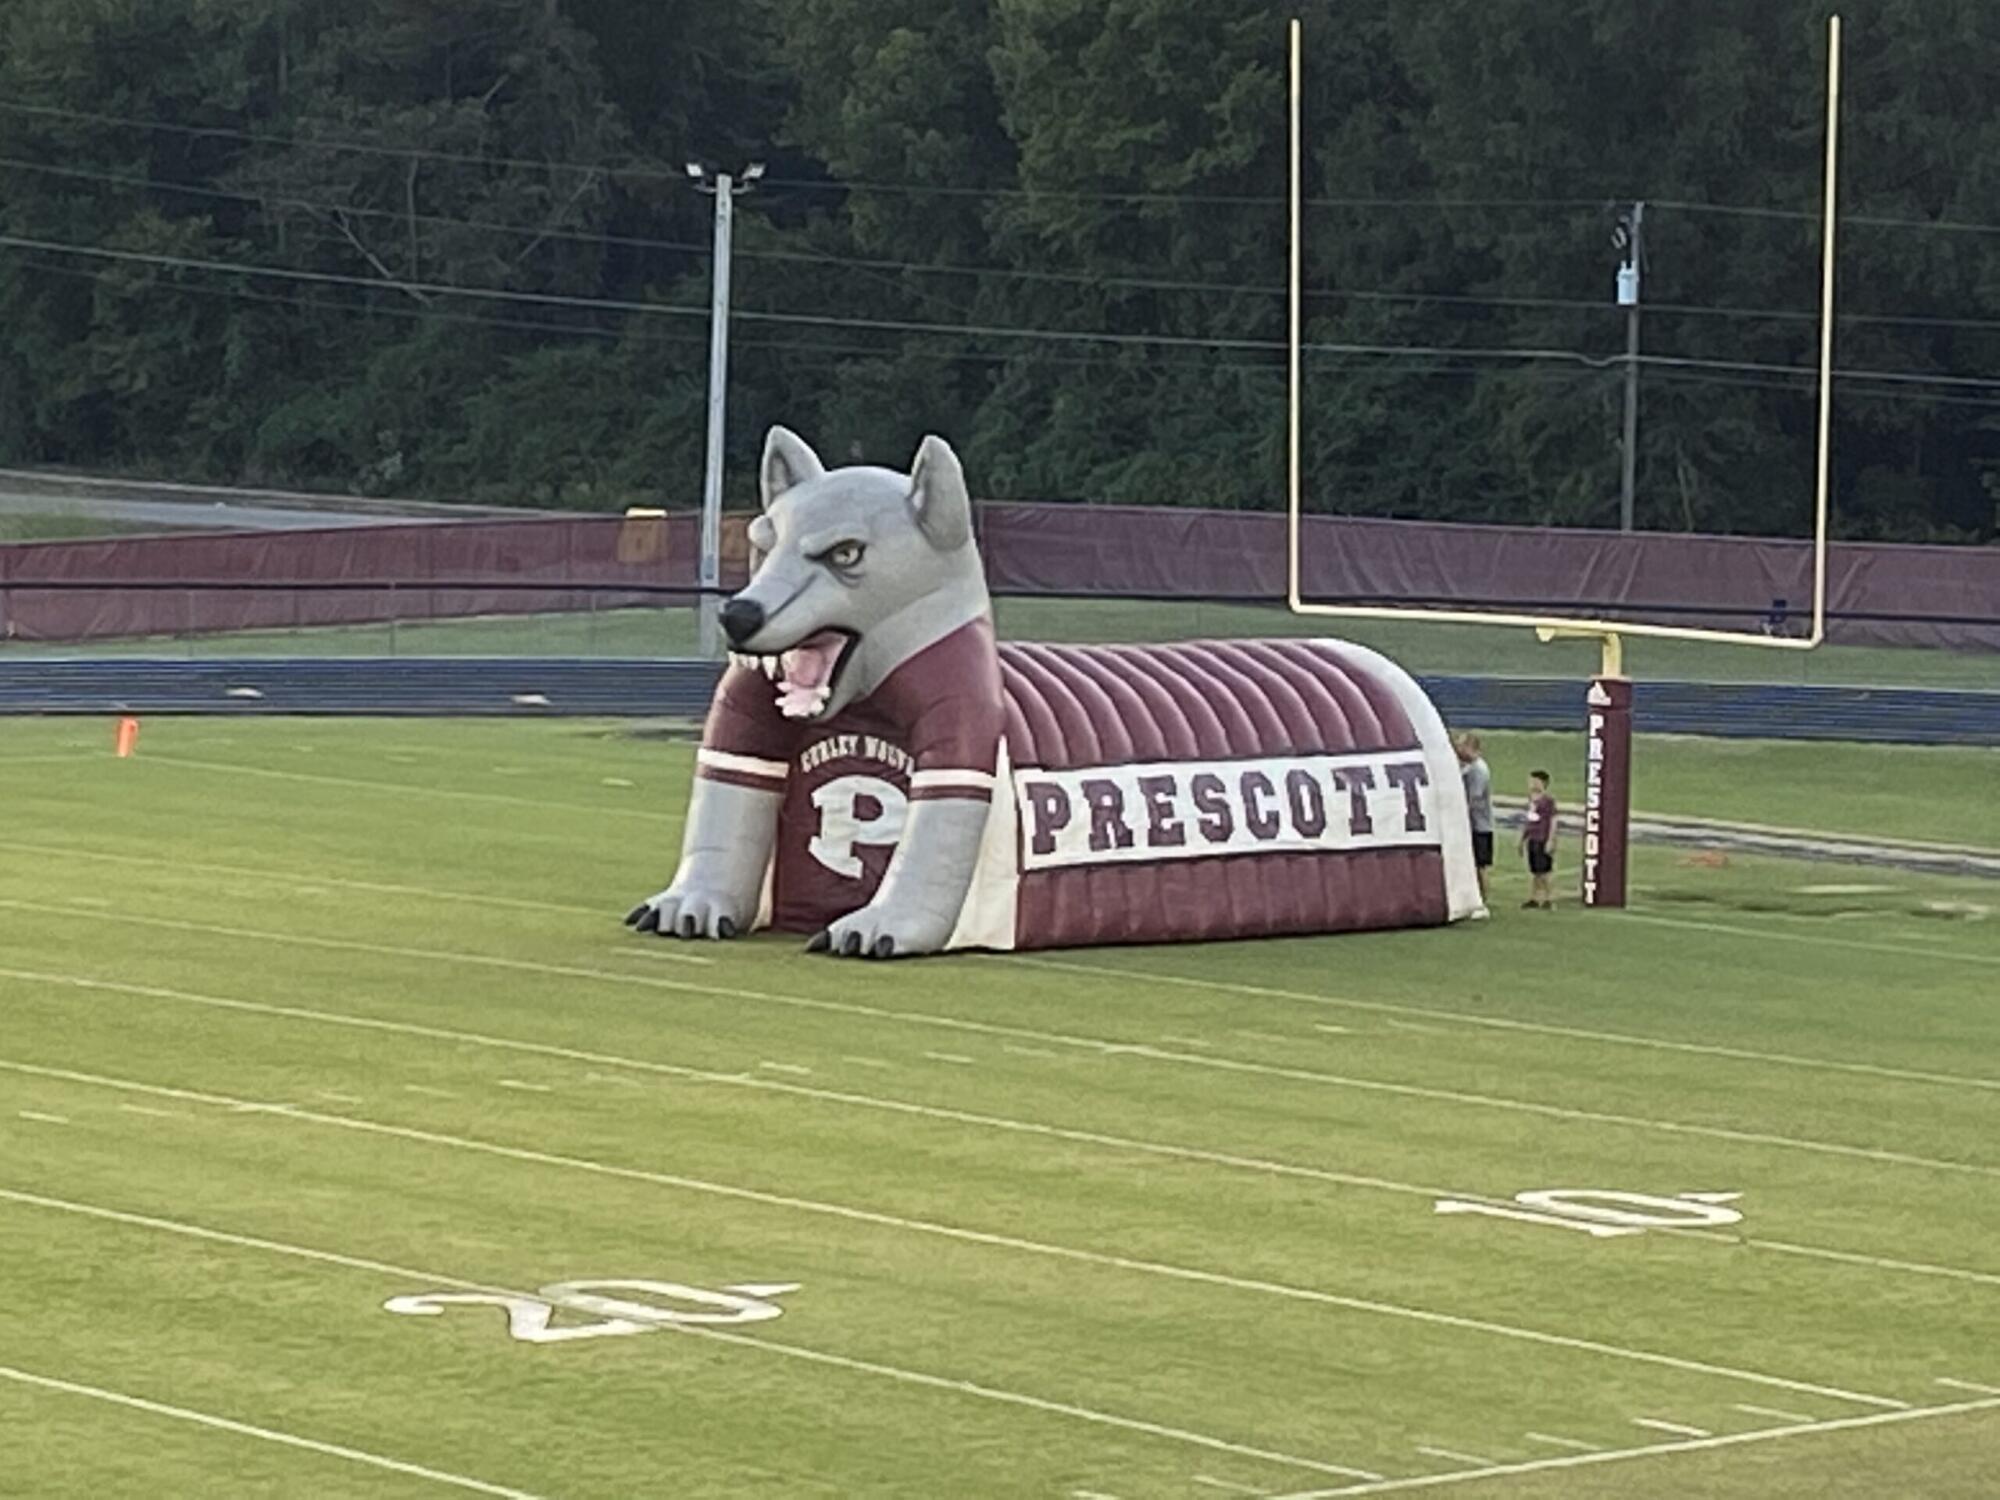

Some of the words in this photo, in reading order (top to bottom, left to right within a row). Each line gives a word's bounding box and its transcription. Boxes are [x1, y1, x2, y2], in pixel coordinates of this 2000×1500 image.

[808, 775, 908, 880] P
[1025, 763, 1429, 854] PRESCOTT
[1583, 714, 1605, 905] PRESCOTT
[1434, 1190, 1744, 1237] 10
[384, 1280, 784, 1342] 20
